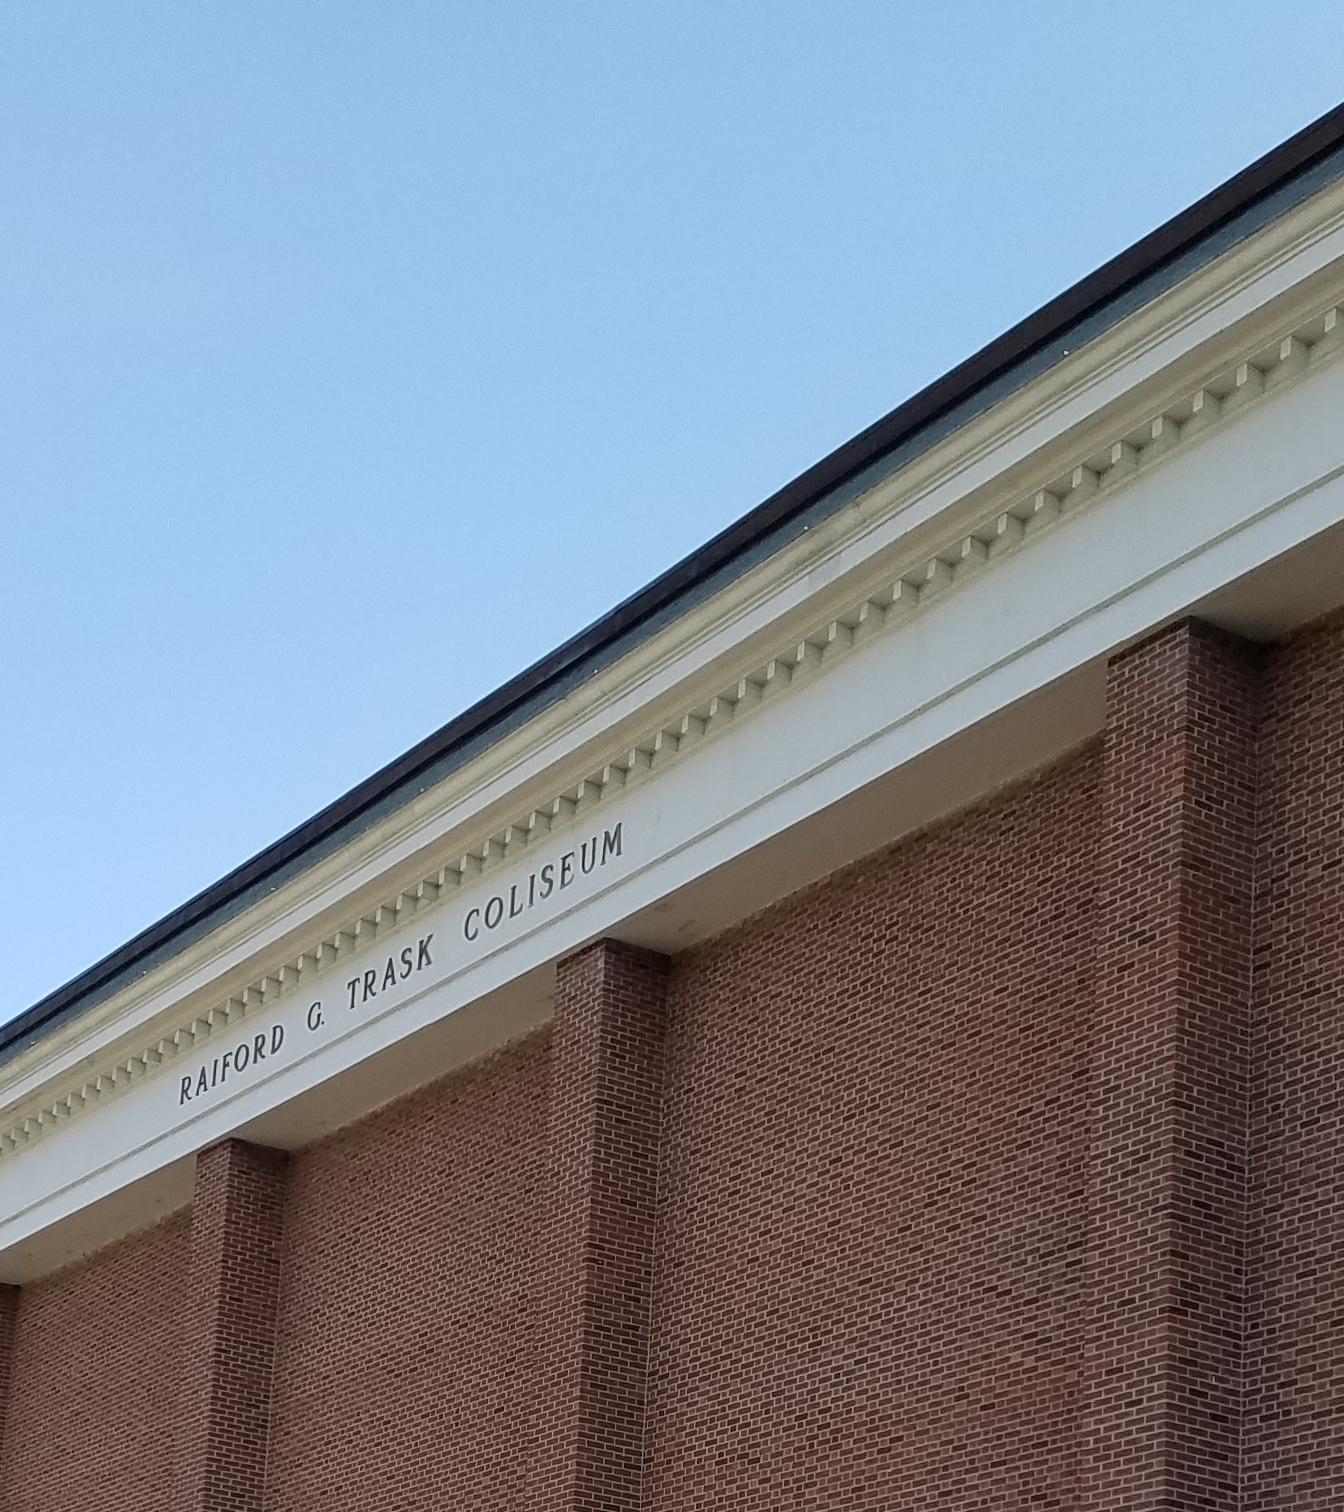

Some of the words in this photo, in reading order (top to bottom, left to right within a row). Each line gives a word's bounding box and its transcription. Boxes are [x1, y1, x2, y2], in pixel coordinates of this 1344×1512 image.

[179, 1024, 285, 1106] RAIFORD
[306, 1001, 326, 1031] G.
[346, 934, 434, 1010] TRASK
[464, 822, 624, 941] COLISEUM
